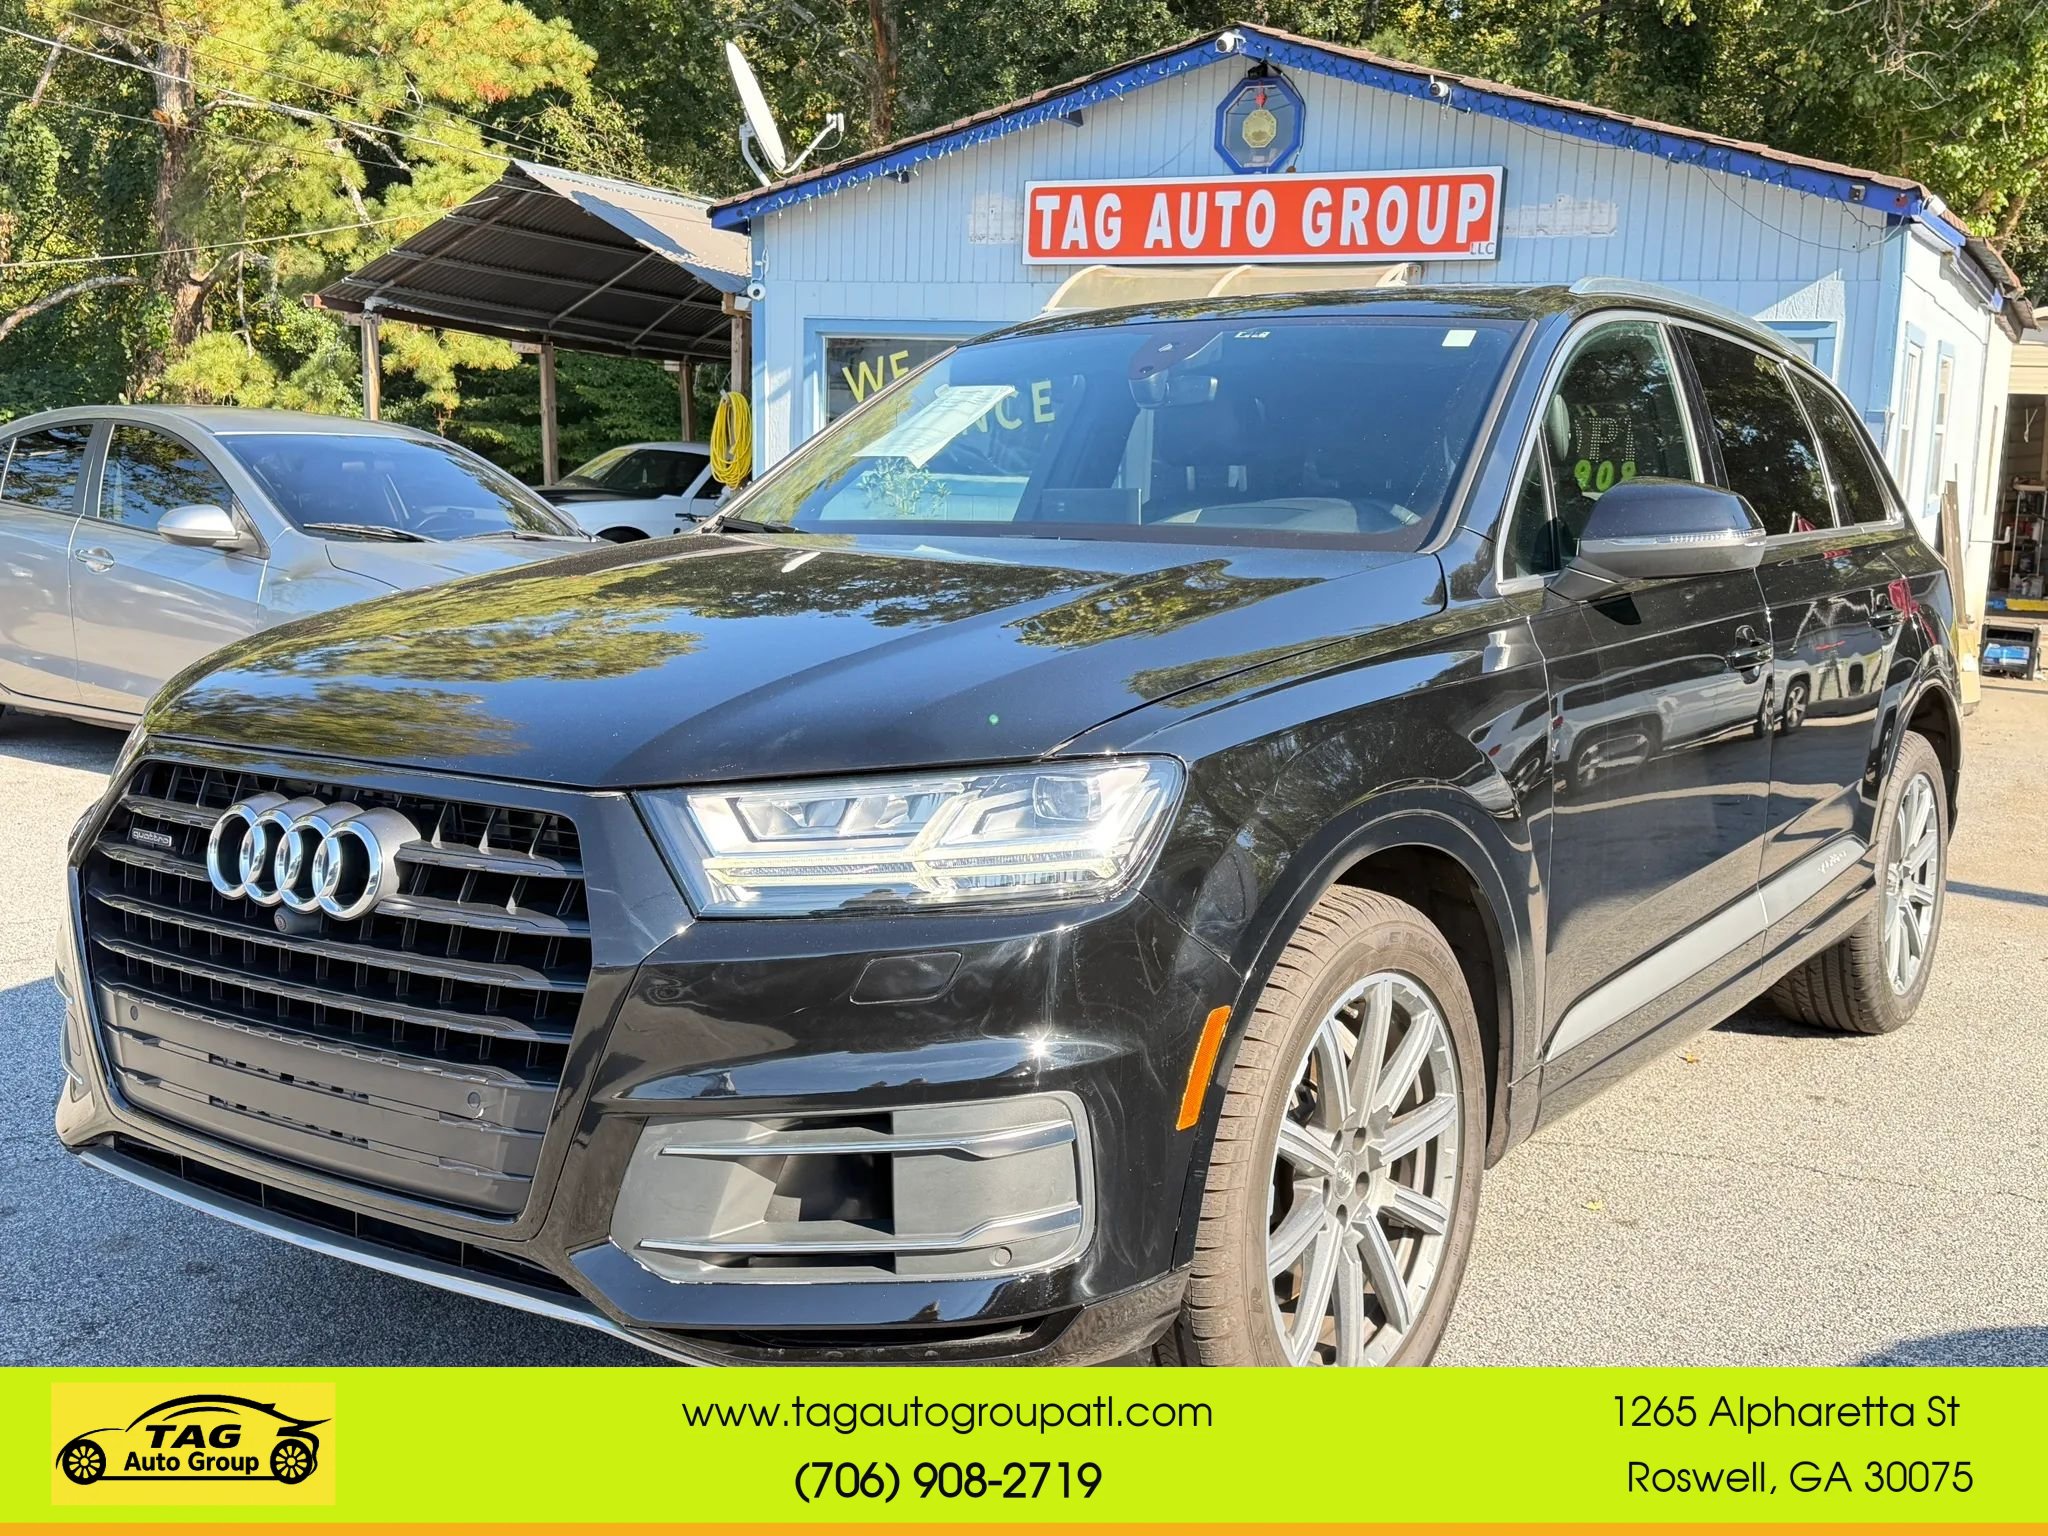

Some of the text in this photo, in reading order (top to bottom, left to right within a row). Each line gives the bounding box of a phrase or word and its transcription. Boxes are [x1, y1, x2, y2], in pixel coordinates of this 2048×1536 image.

[1036, 183, 1486, 249] TAG AUTO GROUP
[1470, 242, 1495, 255] LLC
[841, 350, 910, 403] WE
